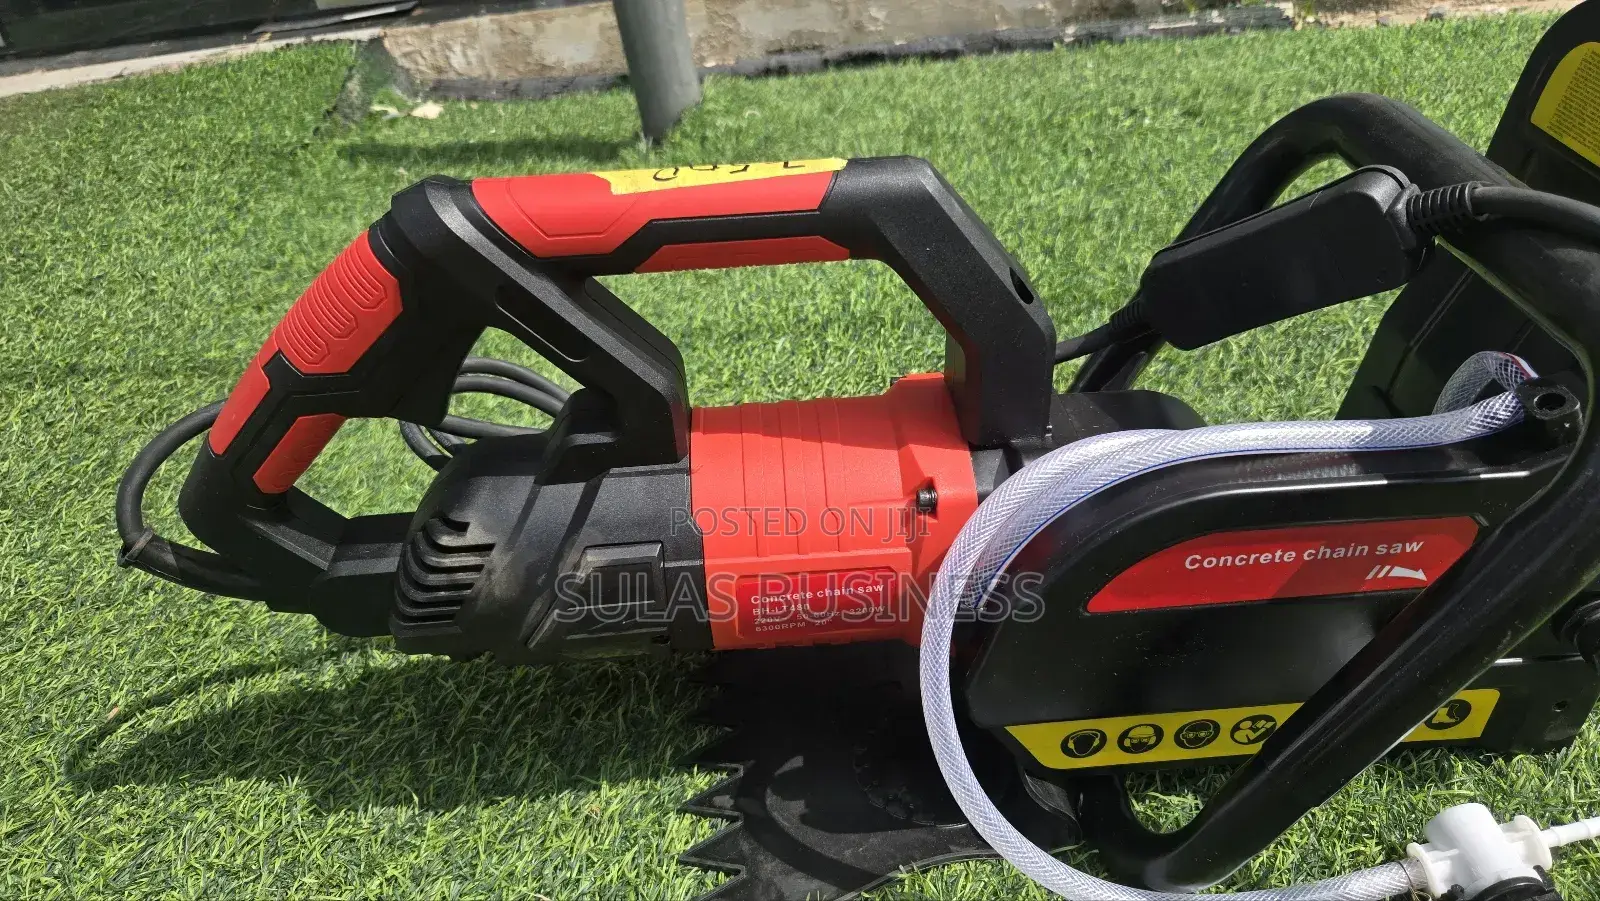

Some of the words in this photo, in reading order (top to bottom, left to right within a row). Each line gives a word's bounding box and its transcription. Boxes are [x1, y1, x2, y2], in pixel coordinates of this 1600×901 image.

[1184, 548, 1297, 570] Concrete
[1303, 542, 1369, 561] chain
[1375, 541, 1424, 555] saw
[751, 591, 813, 604] Concrete
[816, 586, 854, 598] chain
[857, 584, 884, 594] saw
